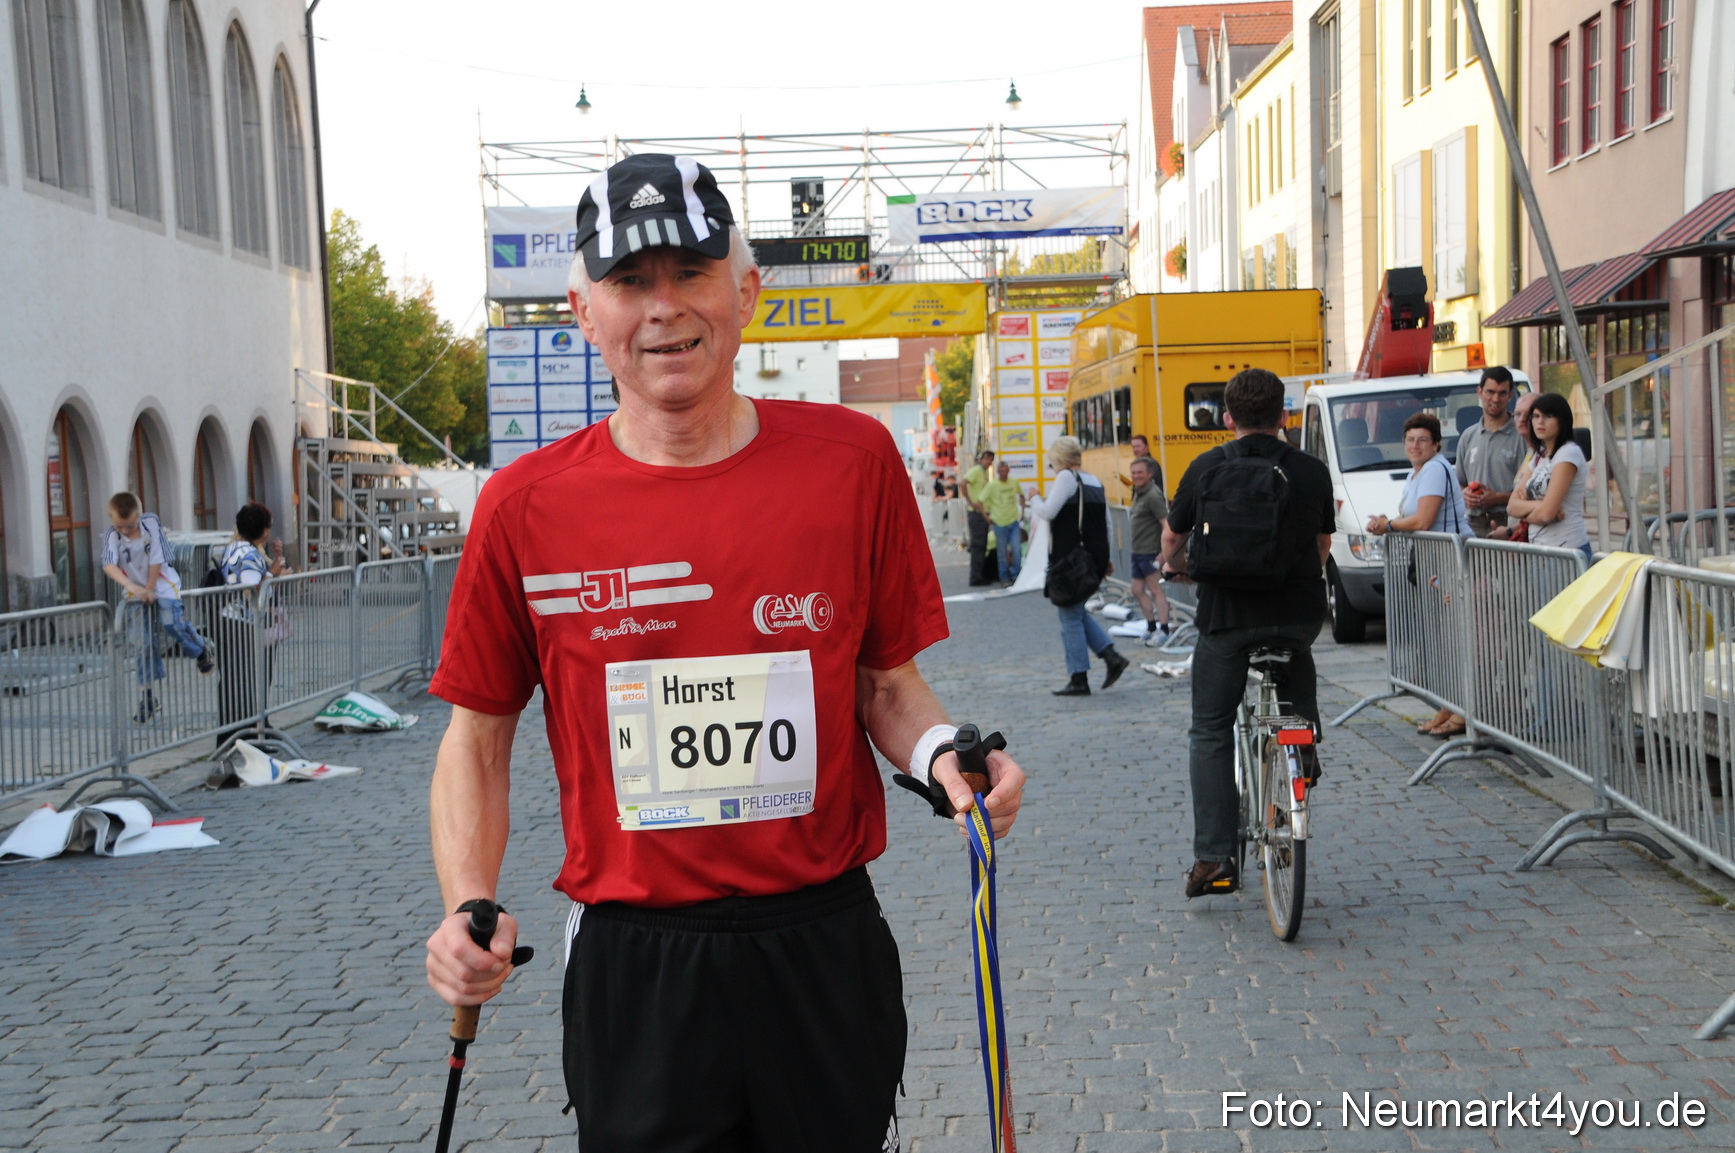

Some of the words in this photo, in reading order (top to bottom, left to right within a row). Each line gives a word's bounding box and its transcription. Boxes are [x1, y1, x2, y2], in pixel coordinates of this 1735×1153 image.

[629, 194, 666, 209] adidas
[917, 199, 1033, 225] BOCK
[763, 298, 845, 328] ZIEL
[774, 594, 805, 618] ASV
[589, 617, 631, 640] Sport
[640, 618, 677, 635] More
[772, 620, 805, 628] NEUMARKT
[662, 675, 735, 705] Horst
[619, 727, 632, 749] N
[670, 719, 797, 769] 8070
[742, 791, 812, 810] PFLEIDERER
[638, 806, 690, 820] BOCK
[971, 807, 987, 837] Stadtlauf
[1004, 1071, 1013, 1115] NORDIC
